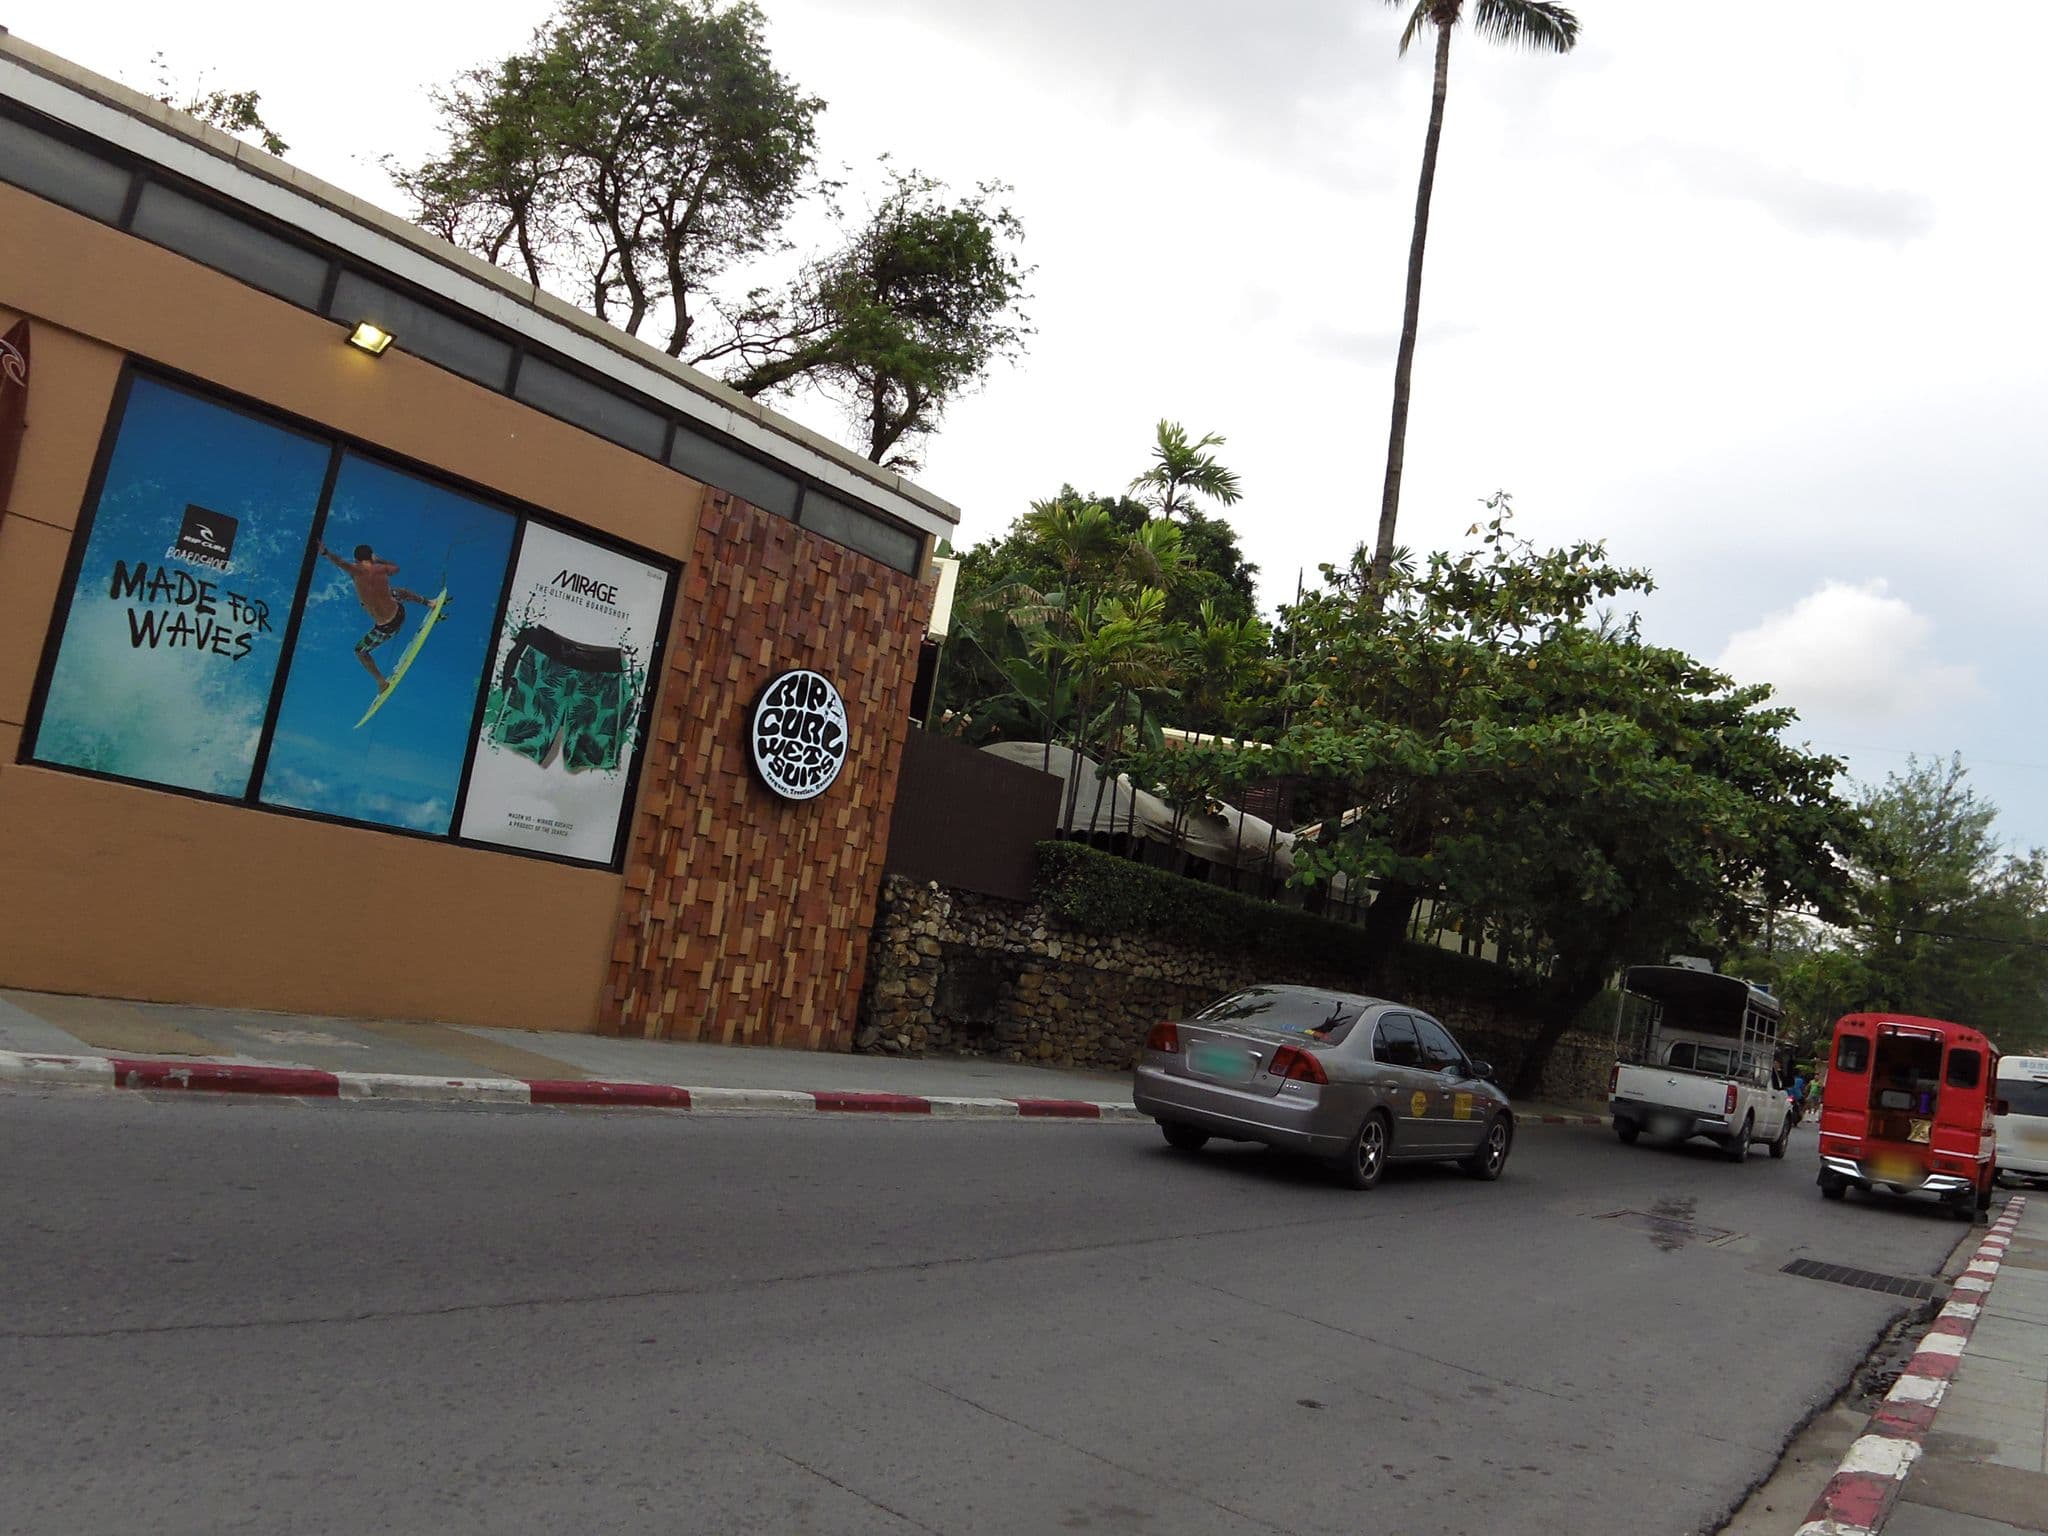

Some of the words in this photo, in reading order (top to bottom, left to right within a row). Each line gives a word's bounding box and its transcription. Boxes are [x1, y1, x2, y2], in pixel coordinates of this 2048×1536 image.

[183, 534, 202, 546] RIP
[201, 541, 228, 554] CURL
[110, 559, 218, 616] MADE
[227, 590, 273, 633] FOR
[535, 583, 549, 595] THE
[549, 588, 584, 606] ULTIMATE
[586, 600, 631, 621] BOARDSHORT
[551, 569, 619, 606] MIRAGE
[127, 607, 253, 661] WAVES
[765, 673, 828, 711] RIP
[757, 707, 844, 759] CURL
